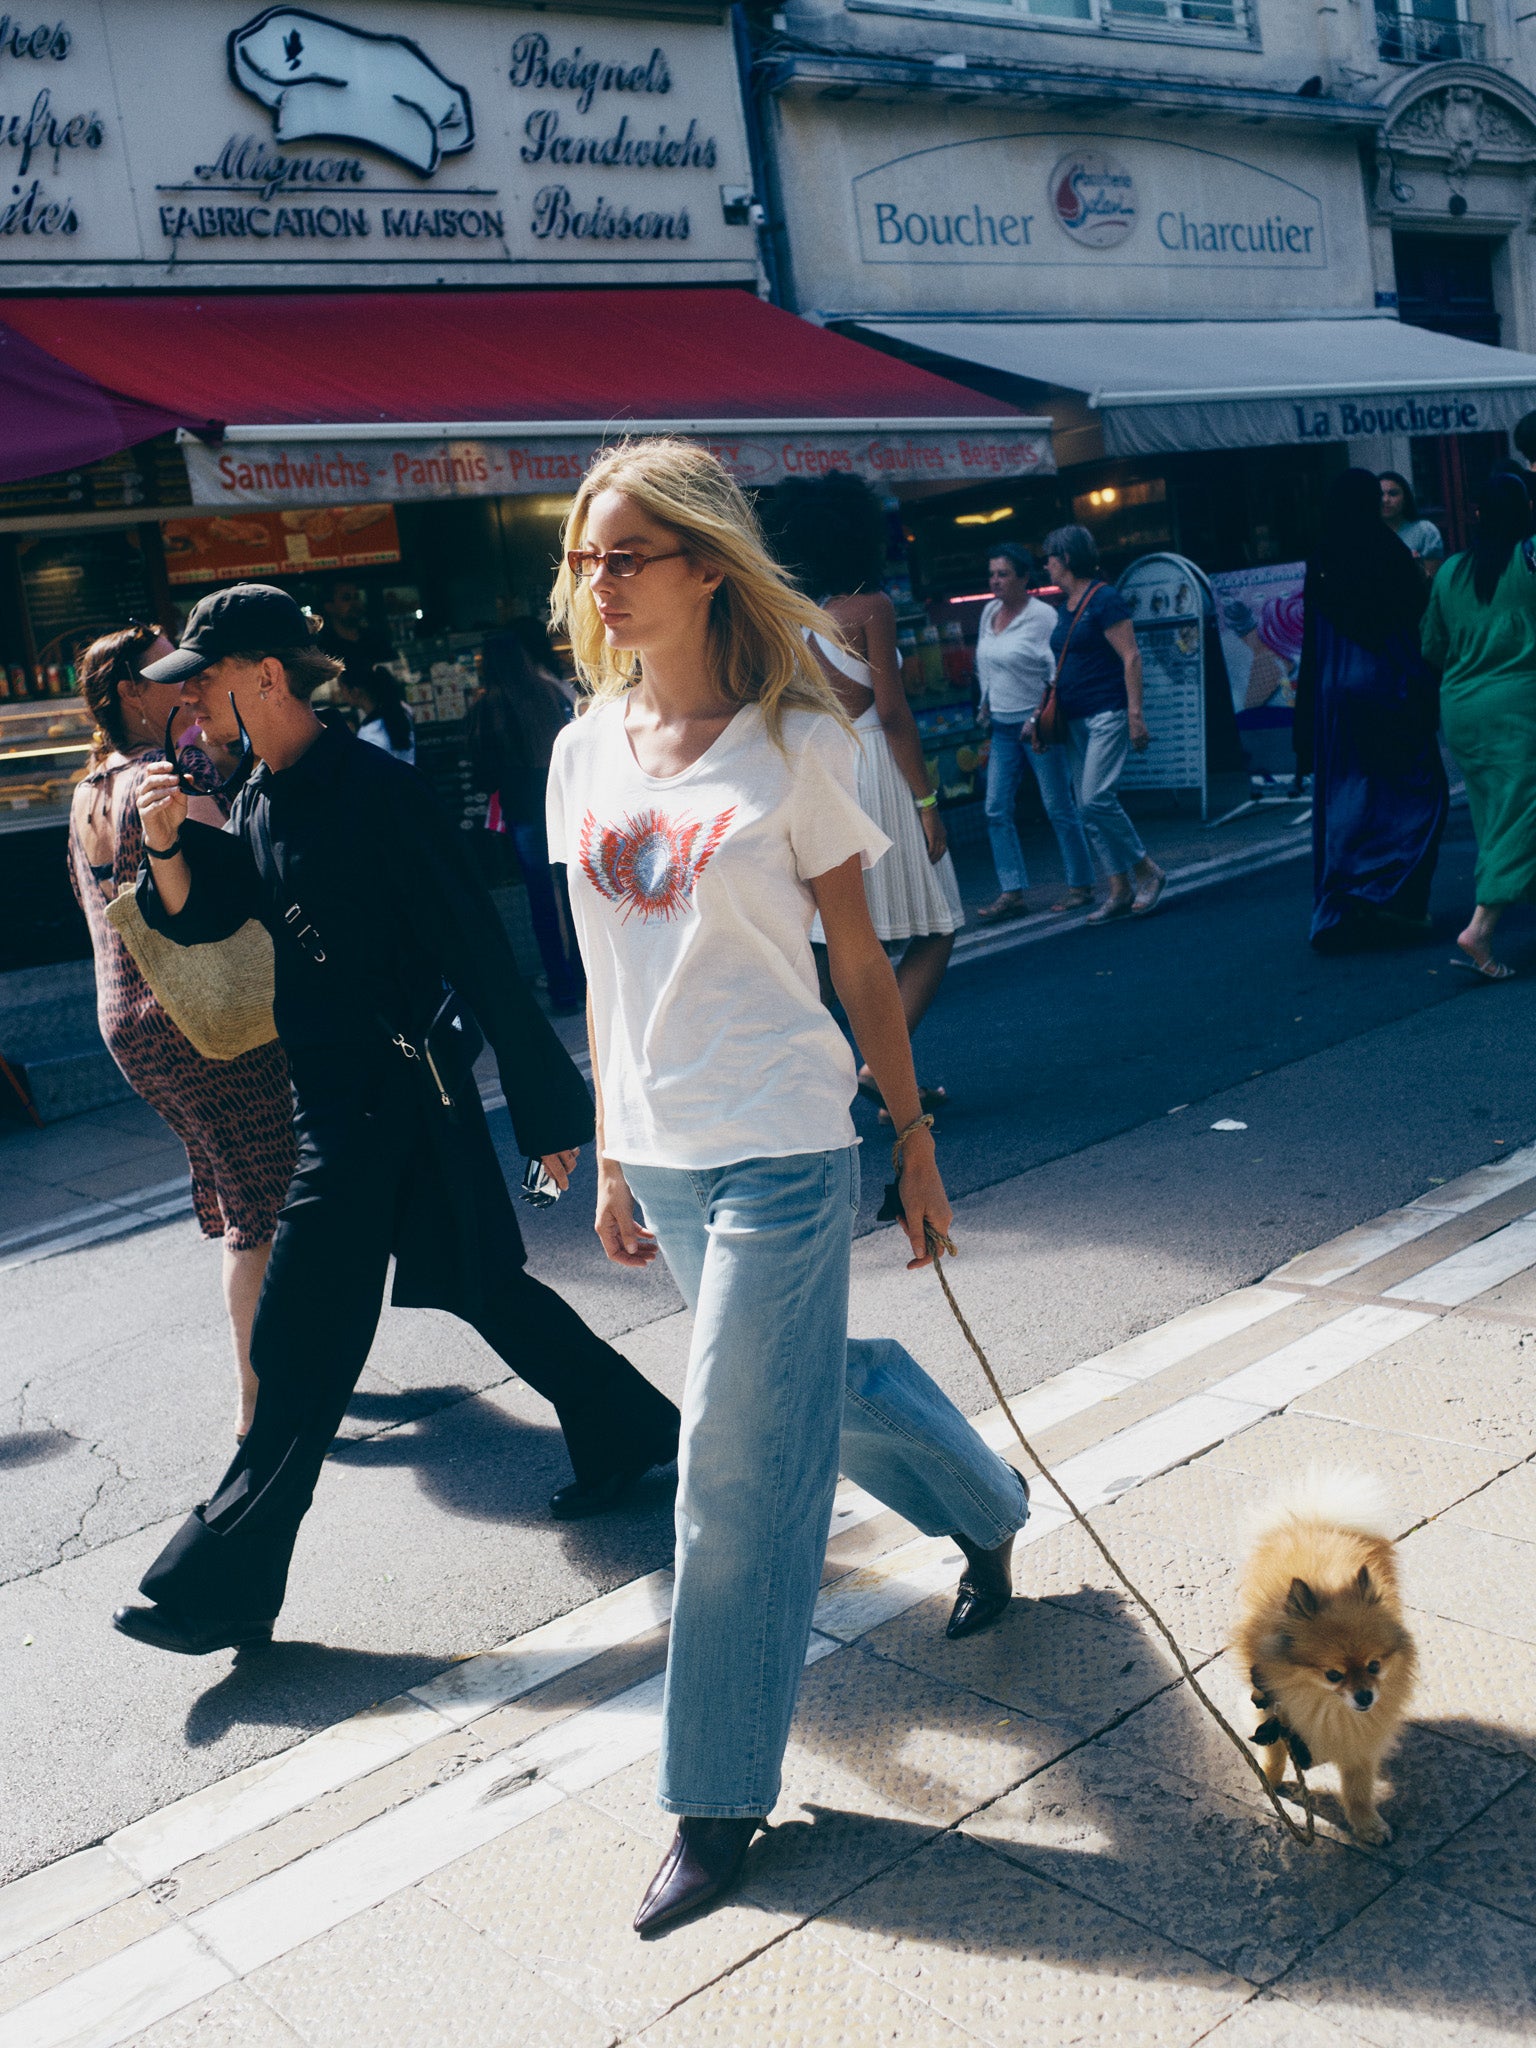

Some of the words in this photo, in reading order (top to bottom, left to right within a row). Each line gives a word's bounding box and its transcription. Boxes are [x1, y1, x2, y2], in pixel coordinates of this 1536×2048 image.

[508, 32, 671, 115] Beignets
[194, 133, 366, 201] Mignon
[159, 205, 371, 239] FABRICATION
[383, 207, 504, 239] MAISON
[531, 184, 691, 241] Boissons
[874, 202, 1034, 247] Boucher
[1156, 210, 1315, 254] Charcutier
[1294, 404, 1331, 438] La
[1338, 397, 1479, 435] Boucherie
[218, 452, 371, 492] Sandwichs
[393, 449, 489, 488] Paninis
[508, 449, 583, 481] Pizzas
[781, 443, 853, 474] Crêpes
[868, 440, 945, 471] Gaufres
[957, 439, 1039, 473] Beignets
